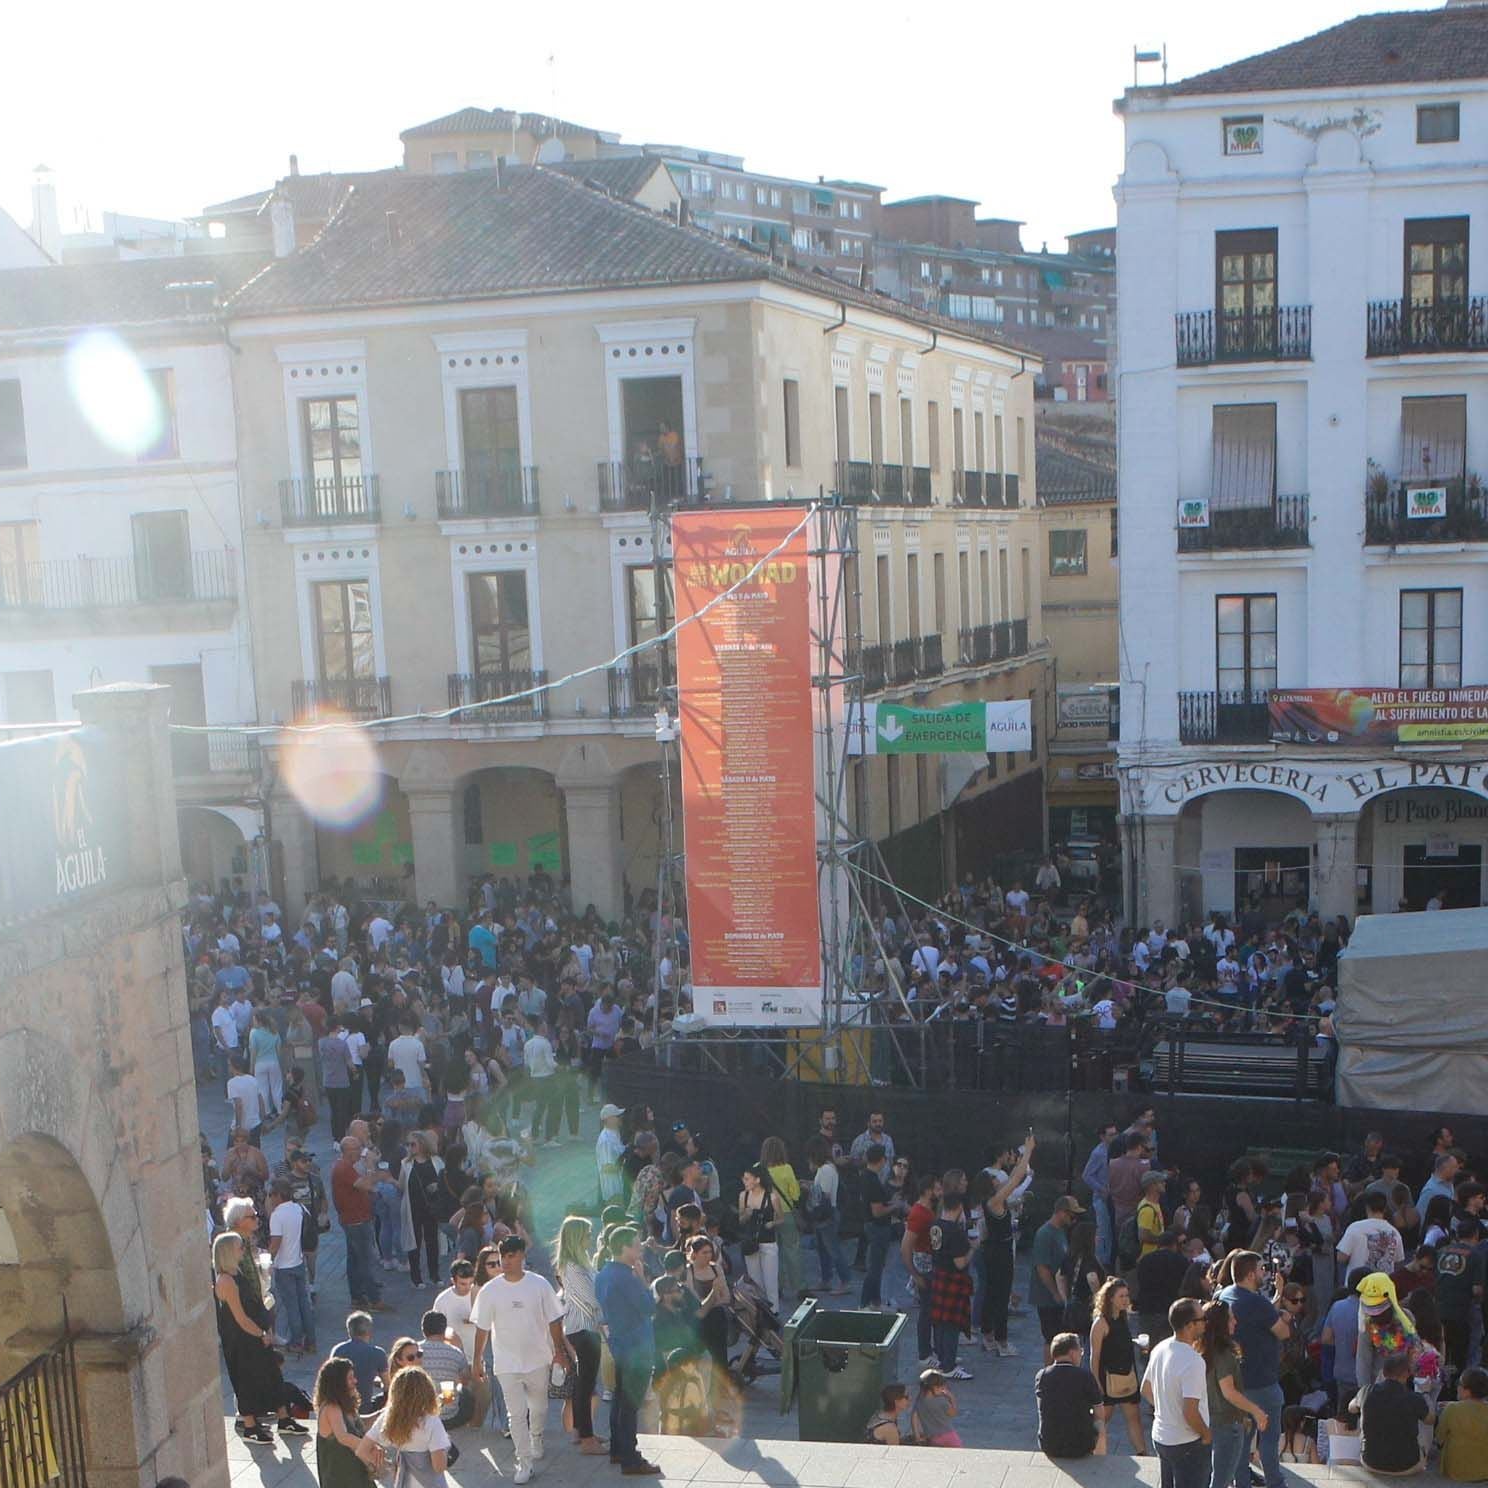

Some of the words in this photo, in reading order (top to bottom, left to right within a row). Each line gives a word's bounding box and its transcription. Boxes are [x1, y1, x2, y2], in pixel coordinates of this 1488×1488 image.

[1416, 491, 1436, 502] NO
[1411, 505, 1441, 514] MINA
[1371, 691, 1395, 704] ALTO
[1397, 691, 1409, 703] EL
[1413, 690, 1445, 703] FUEGO
[912, 713, 954, 724] SALIDA
[955, 712, 972, 723] DE
[1375, 707, 1388, 721] AL
[1391, 706, 1458, 721] SUFRIMIENTO
[1460, 707, 1474, 719] DE
[1476, 706, 1488, 719] LA
[906, 730, 982, 742] EMERGENCIA
[1164, 764, 1328, 803] CERVECERIA
[1383, 800, 1400, 823] El
[1406, 799, 1440, 823] Pato
